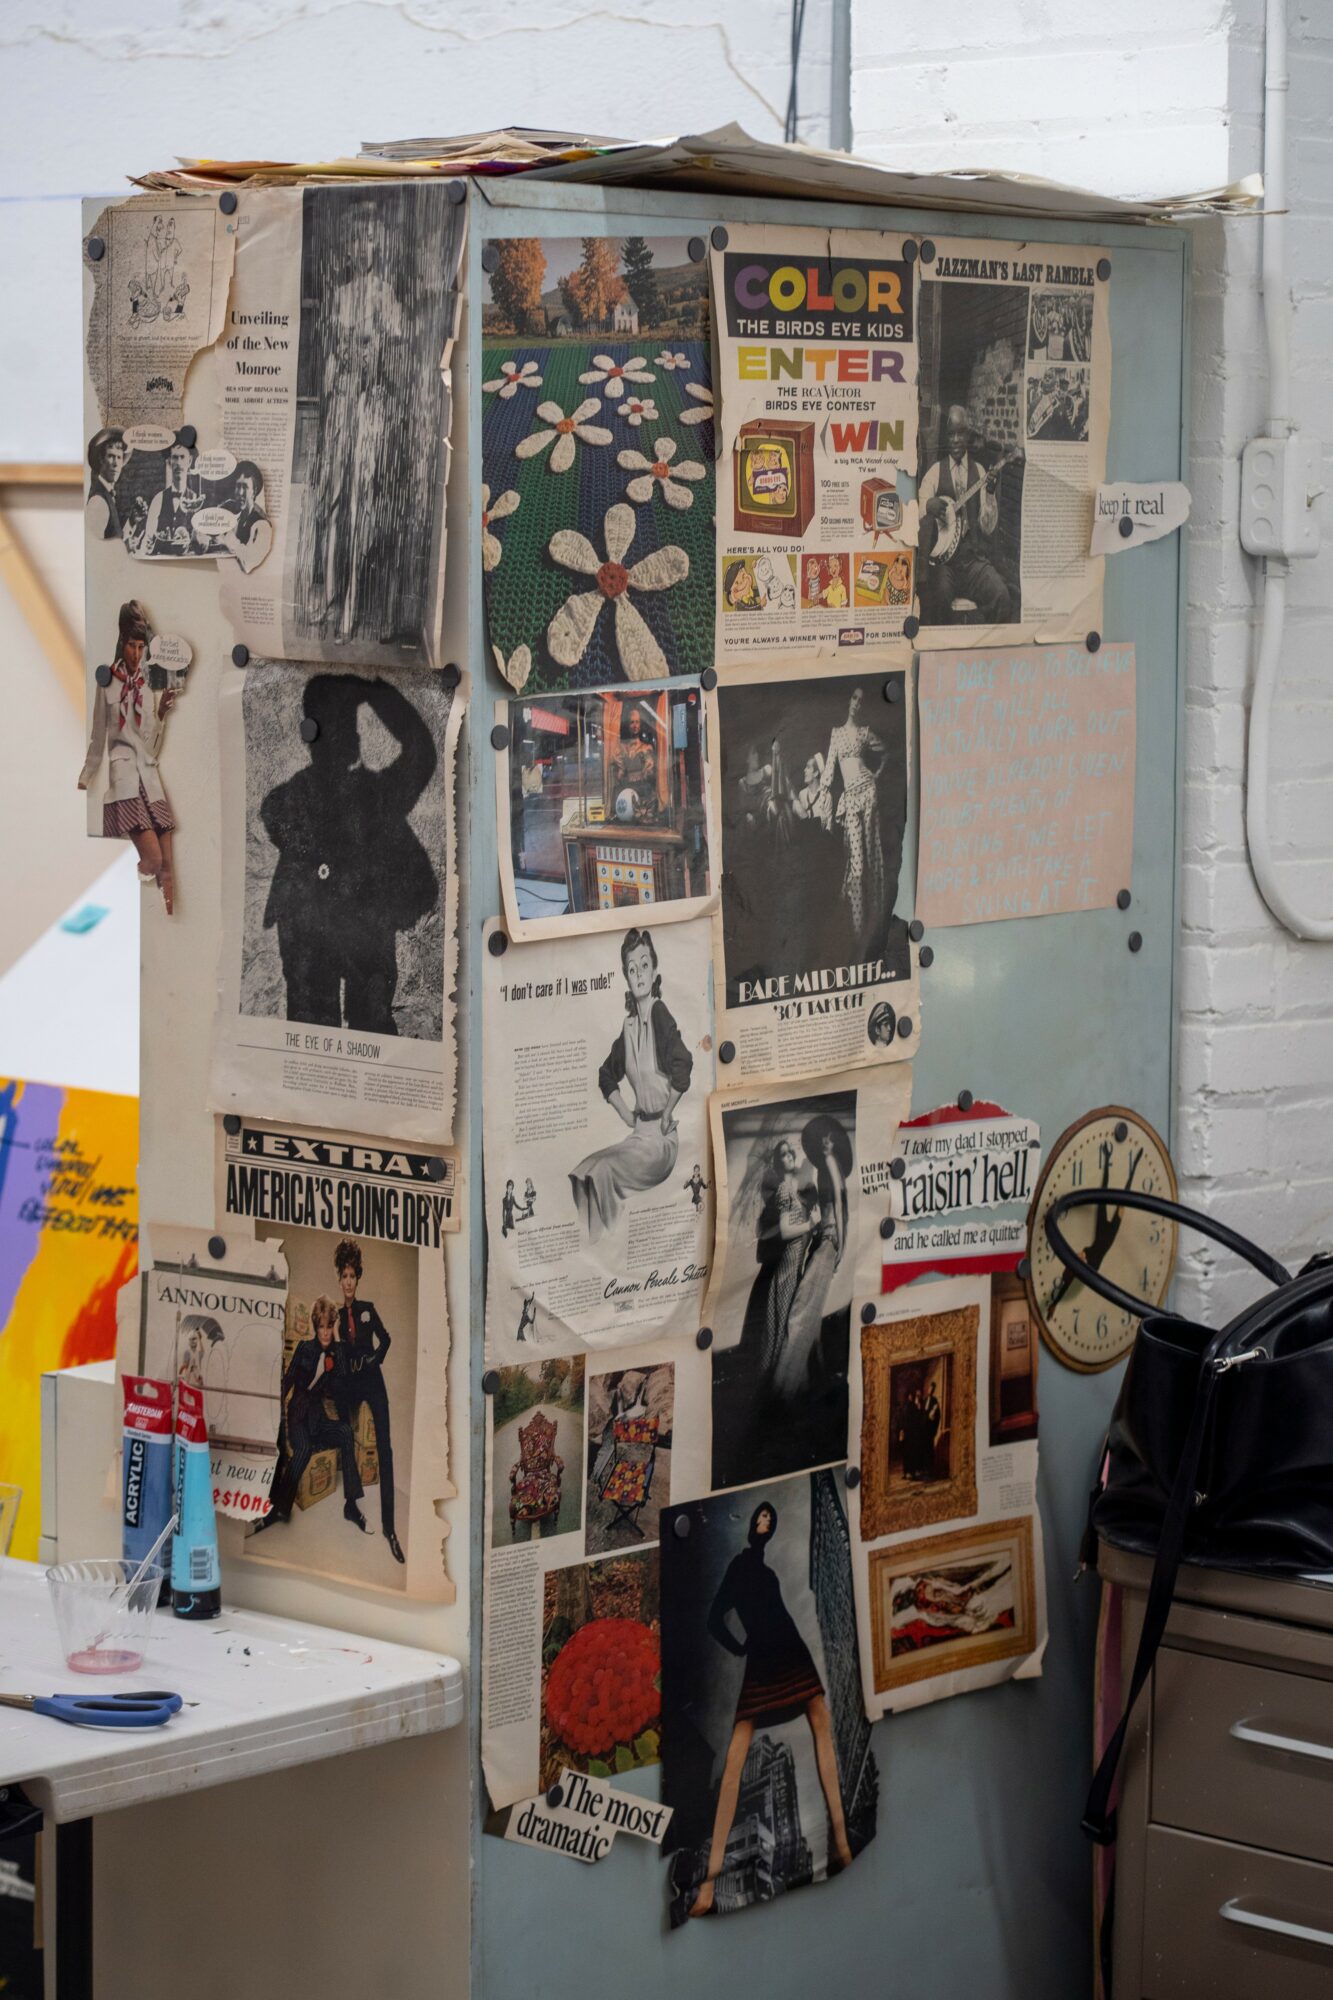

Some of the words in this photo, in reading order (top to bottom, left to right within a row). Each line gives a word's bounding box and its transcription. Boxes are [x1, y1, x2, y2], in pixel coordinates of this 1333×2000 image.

[935, 257, 1009, 280] JAZZMAN'S
[1012, 262, 1043, 283] LAST
[1045, 264, 1095, 287] RAMBLE
[733, 265, 904, 314] COLOR
[231, 310, 289, 329] Unveiling
[737, 319, 770, 334] THE
[775, 320, 825, 337] BIRDS
[831, 322, 861, 337] EYE
[867, 323, 904, 338] KIDS
[226, 336, 240, 350] of
[242, 336, 261, 350] the
[264, 336, 289, 350] New
[235, 361, 281, 376] Monroe
[737, 346, 907, 383] ENTER
[765, 400, 798, 411] BIRDS
[802, 401, 823, 411] EYE
[826, 401, 877, 412] CONTEST
[777, 386, 798, 397] THE
[802, 386, 822, 398] RCA
[830, 420, 905, 453] WIN
[1098, 493, 1120, 524] keep
[1121, 492, 1132, 515] it
[1135, 492, 1164, 515] real
[790, 545, 805, 553] DO!
[724, 637, 750, 646] YOU'RE
[752, 636, 781, 644] ALWAYS
[790, 634, 817, 642] WINNER
[865, 631, 879, 639] FOR
[956, 658, 1003, 691] DARE
[511, 982, 532, 1001] don't
[535, 983, 553, 998] care
[556, 978, 562, 996] if
[571, 979, 588, 995] was
[738, 974, 791, 1003] BARE
[285, 1032, 300, 1047] THE
[304, 1035, 320, 1050] EYE
[323, 1037, 334, 1052] OF
[336, 1039, 342, 1052] A
[347, 1041, 381, 1059] SHADOW
[912, 1137, 932, 1155] told
[935, 1137, 951, 1155] my
[954, 1132, 976, 1149] dad
[986, 1126, 1028, 1151] stopped
[263, 1135, 414, 1177] EXTRA
[982, 1149, 1031, 1204] hell,
[1072, 1160, 1083, 1186] 11
[225, 1163, 333, 1230] AMERICA'S
[337, 1179, 400, 1242] GOING
[894, 1233, 914, 1251] and
[916, 1231, 928, 1249] he
[931, 1228, 960, 1248] called
[963, 1231, 977, 1245] me
[980, 1230, 987, 1243] a
[604, 1277, 641, 1299] Cannon
[643, 1268, 678, 1291] Percale
[1072, 1308, 1080, 1335] 7
[1096, 1313, 1108, 1339] 6
[125, 1440, 144, 1525] ACRYLIC
[226, 1463, 257, 1482] new
[563, 1772, 603, 1817] The
[603, 1796, 665, 1839] most
[517, 1802, 609, 1861] dramatic
